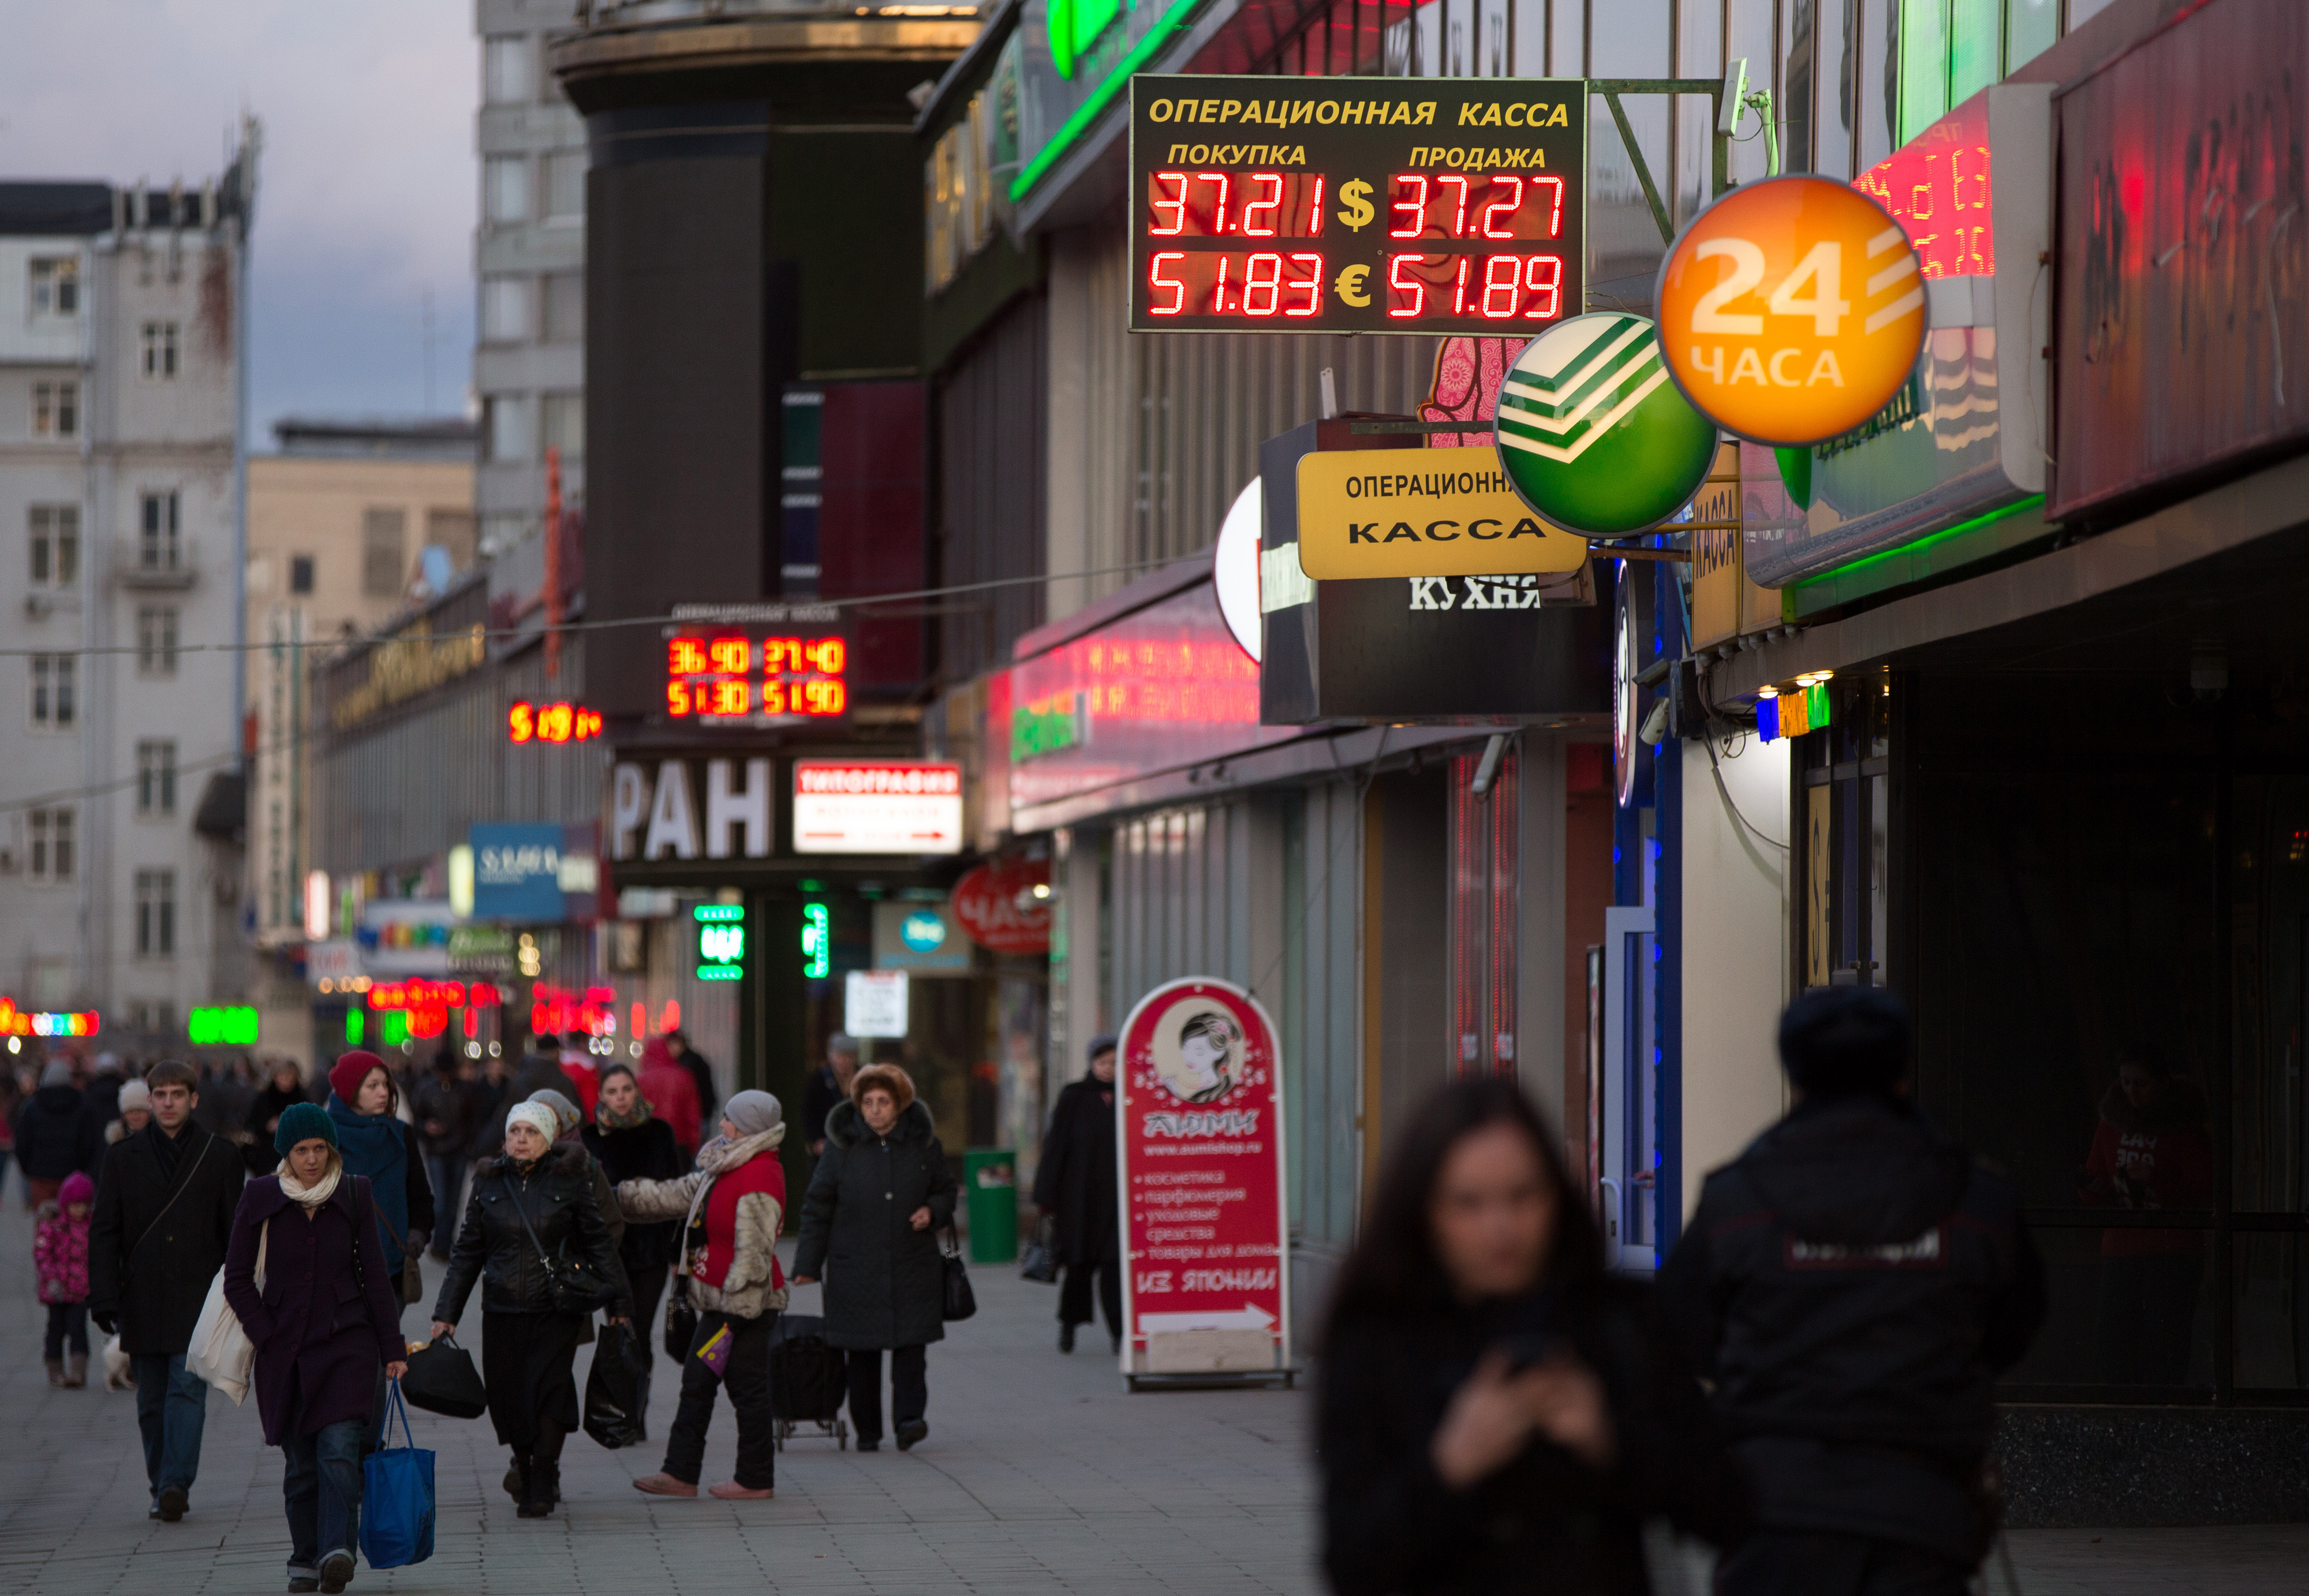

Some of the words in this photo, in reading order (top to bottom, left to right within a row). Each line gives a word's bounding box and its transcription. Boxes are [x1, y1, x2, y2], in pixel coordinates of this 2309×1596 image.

[1149, 99, 1437, 128] ОПЕРАЦИОННАЯ
[1458, 103, 1568, 127] КАССА
[1167, 144, 1306, 165] ПОКУПКА
[1409, 147, 1546, 170] ПРОДАЖА
[1150, 173, 1323, 236] 37.21
[1337, 178, 1375, 233] $
[1390, 175, 1563, 238] 37.27
[1150, 252, 1324, 316] 51.83
[1333, 263, 1372, 308] €
[1389, 254, 1563, 319] 51.89
[1690, 237, 1851, 337] 24
[1690, 345, 1845, 388] ЧАСА
[1346, 471, 1514, 499] ОПЕРАЦИОНН
[1349, 518, 1547, 544] КАССА
[1696, 489, 1735, 580] КАССА
[612, 758, 775, 861] РАН
[1144, 1171, 1226, 1185] косметика
[1145, 1187, 1246, 1207] парфюмерия
[1146, 1225, 1216, 1246] средства
[1148, 1244, 1204, 1264] товары
[1206, 1243, 1234, 1258] для
[1137, 1270, 1174, 1293] ИЗ
[1182, 1268, 1277, 1292] ЯПОНИИ
